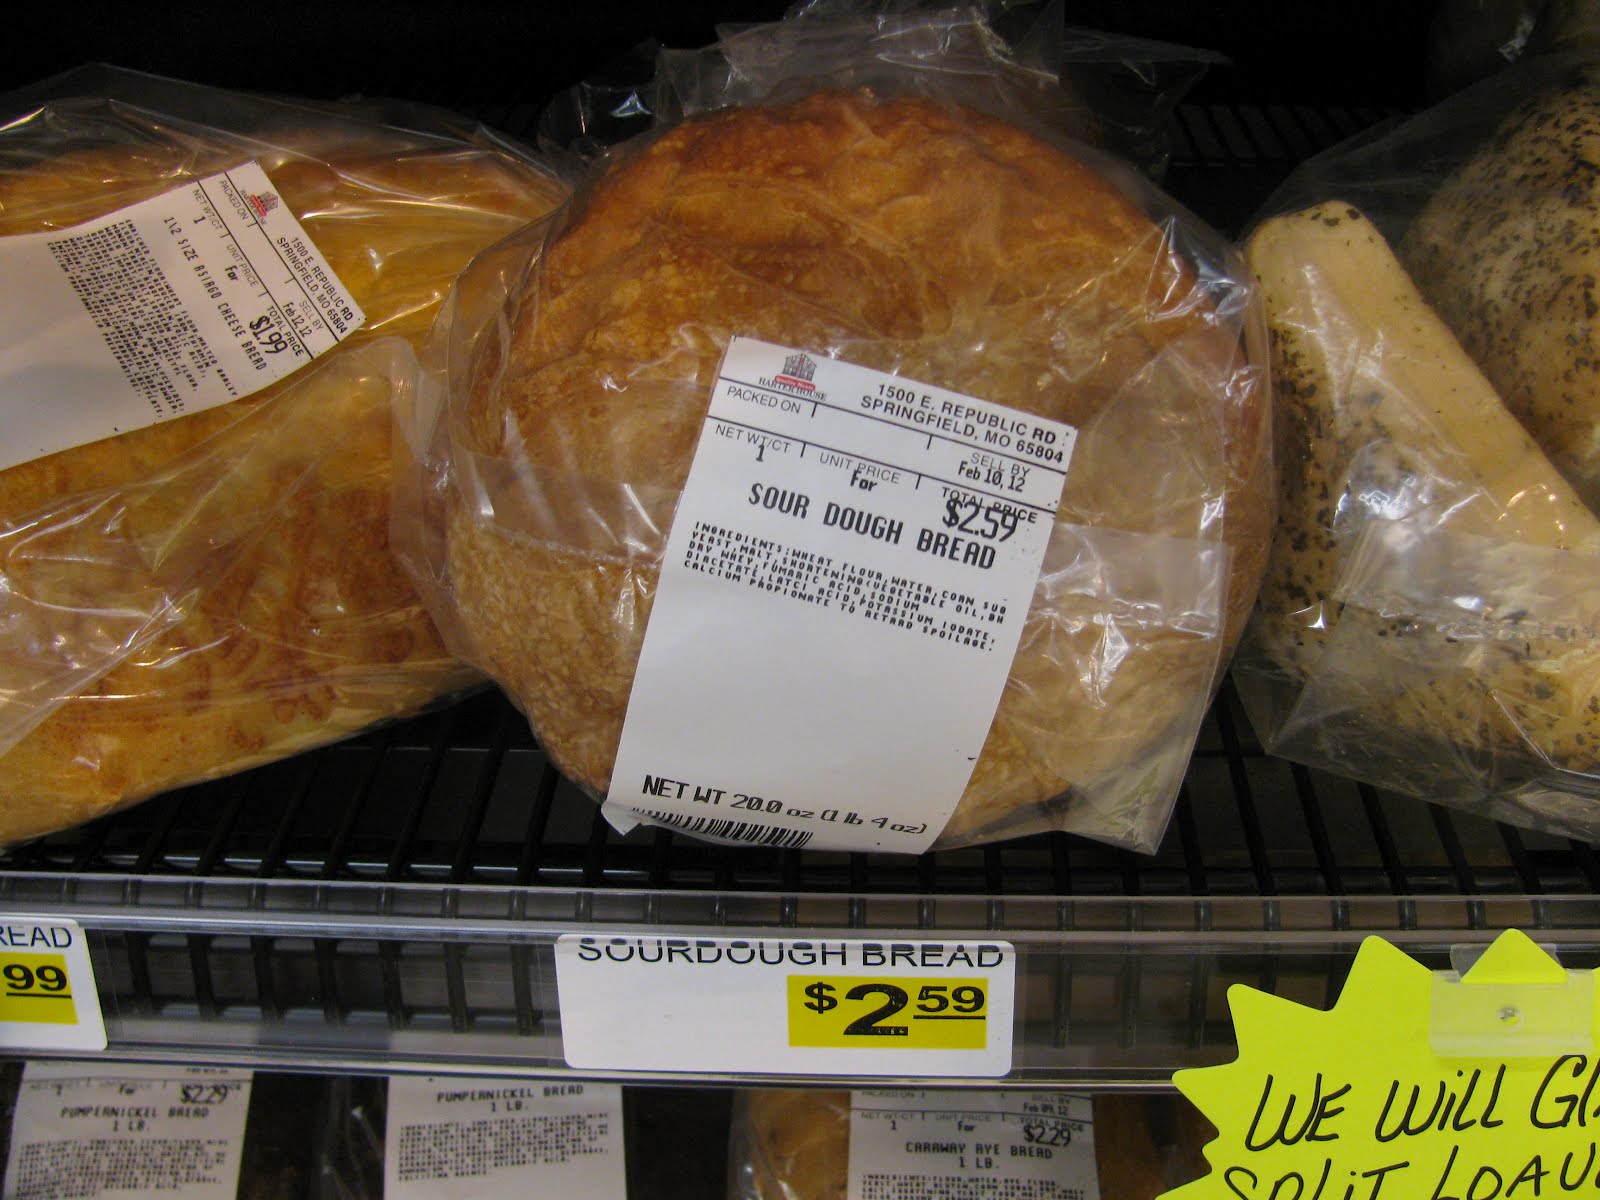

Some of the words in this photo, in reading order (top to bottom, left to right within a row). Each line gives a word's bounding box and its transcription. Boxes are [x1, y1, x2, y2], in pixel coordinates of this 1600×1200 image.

[191, 189, 208, 206] NET
[218, 179, 241, 207] PACKED
[235, 206, 249, 220] ON
[223, 263, 242, 283] For
[226, 243, 244, 263] UNIT
[237, 262, 259, 287] PRICE
[290, 236, 310, 257] 1500
[310, 266, 345, 308] REPUBLIC
[338, 307, 354, 321] RD
[275, 237, 321, 294] SPRINGFIELD,
[315, 294, 331, 309] MO
[325, 308, 348, 333] 65804
[176, 238, 199, 262] SIZE
[192, 264, 222, 299] ASIAGO
[216, 302, 246, 337] CHEESE
[240, 340, 267, 371] BREAD
[281, 302, 298, 317] Feb
[297, 326, 312, 337] 12
[297, 300, 316, 319] SELL
[310, 318, 324, 331] BY
[245, 314, 289, 357] $1.99
[265, 305, 288, 331] TOTAL
[282, 330, 304, 356] PRICE
[726, 385, 777, 408] PACKED
[779, 399, 801, 414] ON
[876, 383, 915, 404] 1500
[920, 395, 937, 410] E.
[940, 401, 1028, 436] REPUBLIC
[1031, 427, 1056, 445] RD
[714, 424, 744, 441] NET
[746, 432, 791, 454] WT/CT
[859, 395, 980, 441] SPRINGFIELD,
[983, 429, 1011, 448] MO
[1015, 439, 1064, 463] 65804
[755, 444, 767, 462] 1
[818, 452, 850, 470] UNIT
[855, 462, 901, 484] PRICE
[969, 451, 1007, 471] SELL
[1010, 463, 1030, 479] BY
[849, 468, 879, 493] For
[957, 461, 982, 480] Feb
[1006, 475, 1026, 492] 12
[939, 486, 988, 510] TOTAL
[991, 501, 1038, 524] PRICE
[940, 494, 1021, 545] $2.59
[747, 482, 811, 519] SOUR
[821, 502, 904, 545] DOUGH
[915, 527, 997, 571] BREAD
[683, 559, 741, 582] CALCIUM
[749, 577, 830, 606] PROPIONATE
[839, 602, 855, 613] TO
[864, 609, 913, 629] RETARD
[688, 541, 712, 554] DRY
[828, 579, 920, 611] ACID,SODIUM
[642, 774, 690, 799] NET
[693, 786, 727, 805] WT
[730, 793, 784, 814] 20.0
[787, 808, 815, 819] oz
[844, 812, 863, 826] lb
[870, 817, 888, 830] 4
[890, 823, 928, 835] oz)
[577, 937, 848, 966] SOURDOUGH
[861, 942, 1004, 968] BREAD
[437, 1087, 534, 1102] PUMPERNICKEL
[543, 1084, 584, 1097] BREAD
[1244, 1073, 1352, 1152] WE
[1530, 1054, 1600, 1129] GI
[60, 1106, 158, 1119] PUMPERNICKEL
[168, 1106, 209, 1119] BREAD
[906, 1141, 966, 1155] CARAWAY
[976, 1143, 1000, 1155] RYE
[1010, 1145, 1052, 1159] BREAD
